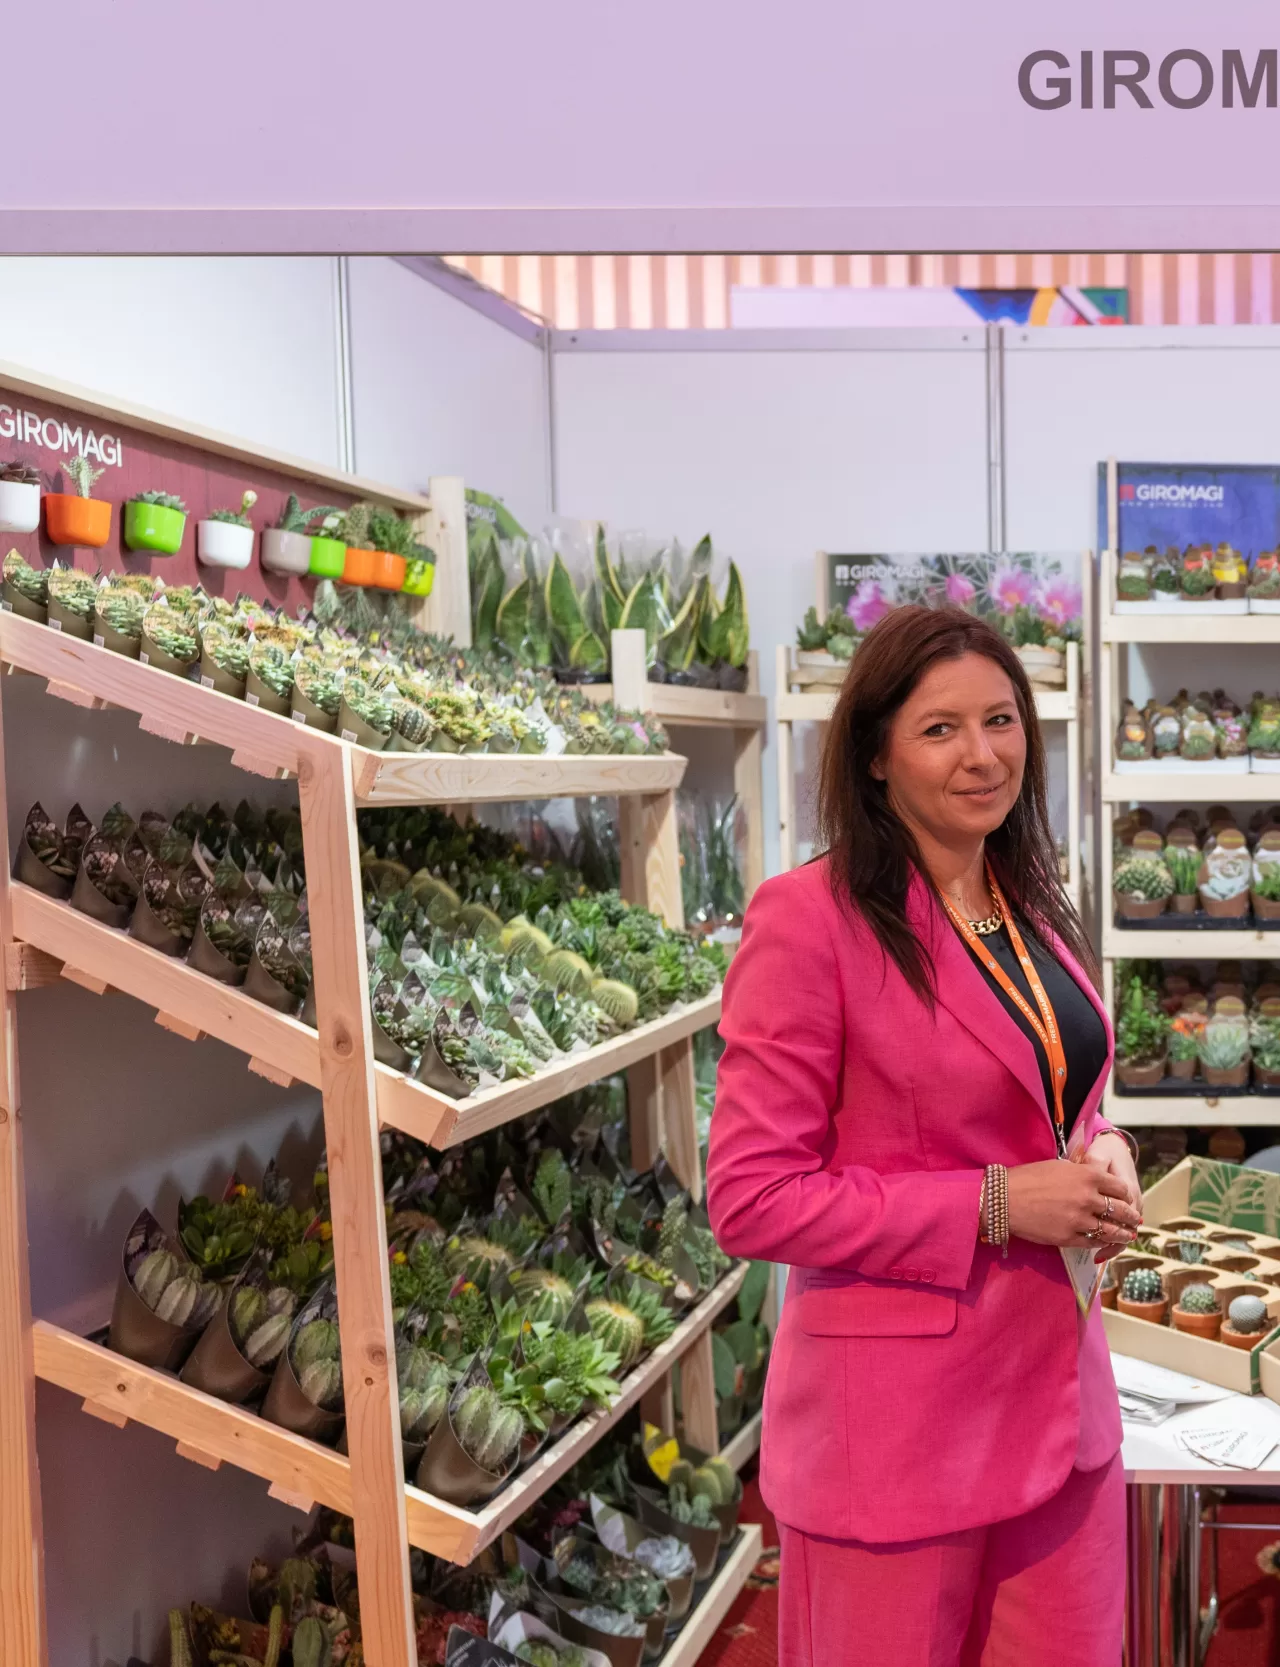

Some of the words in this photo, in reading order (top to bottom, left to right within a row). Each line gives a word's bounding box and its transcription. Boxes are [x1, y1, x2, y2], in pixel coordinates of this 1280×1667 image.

[0, 404, 122, 467] GIROMAGI
[1136, 484, 1224, 501] GIROMAGI
[850, 564, 925, 580] GIROMAGI
[1028, 1011, 1049, 1043] MARKET
